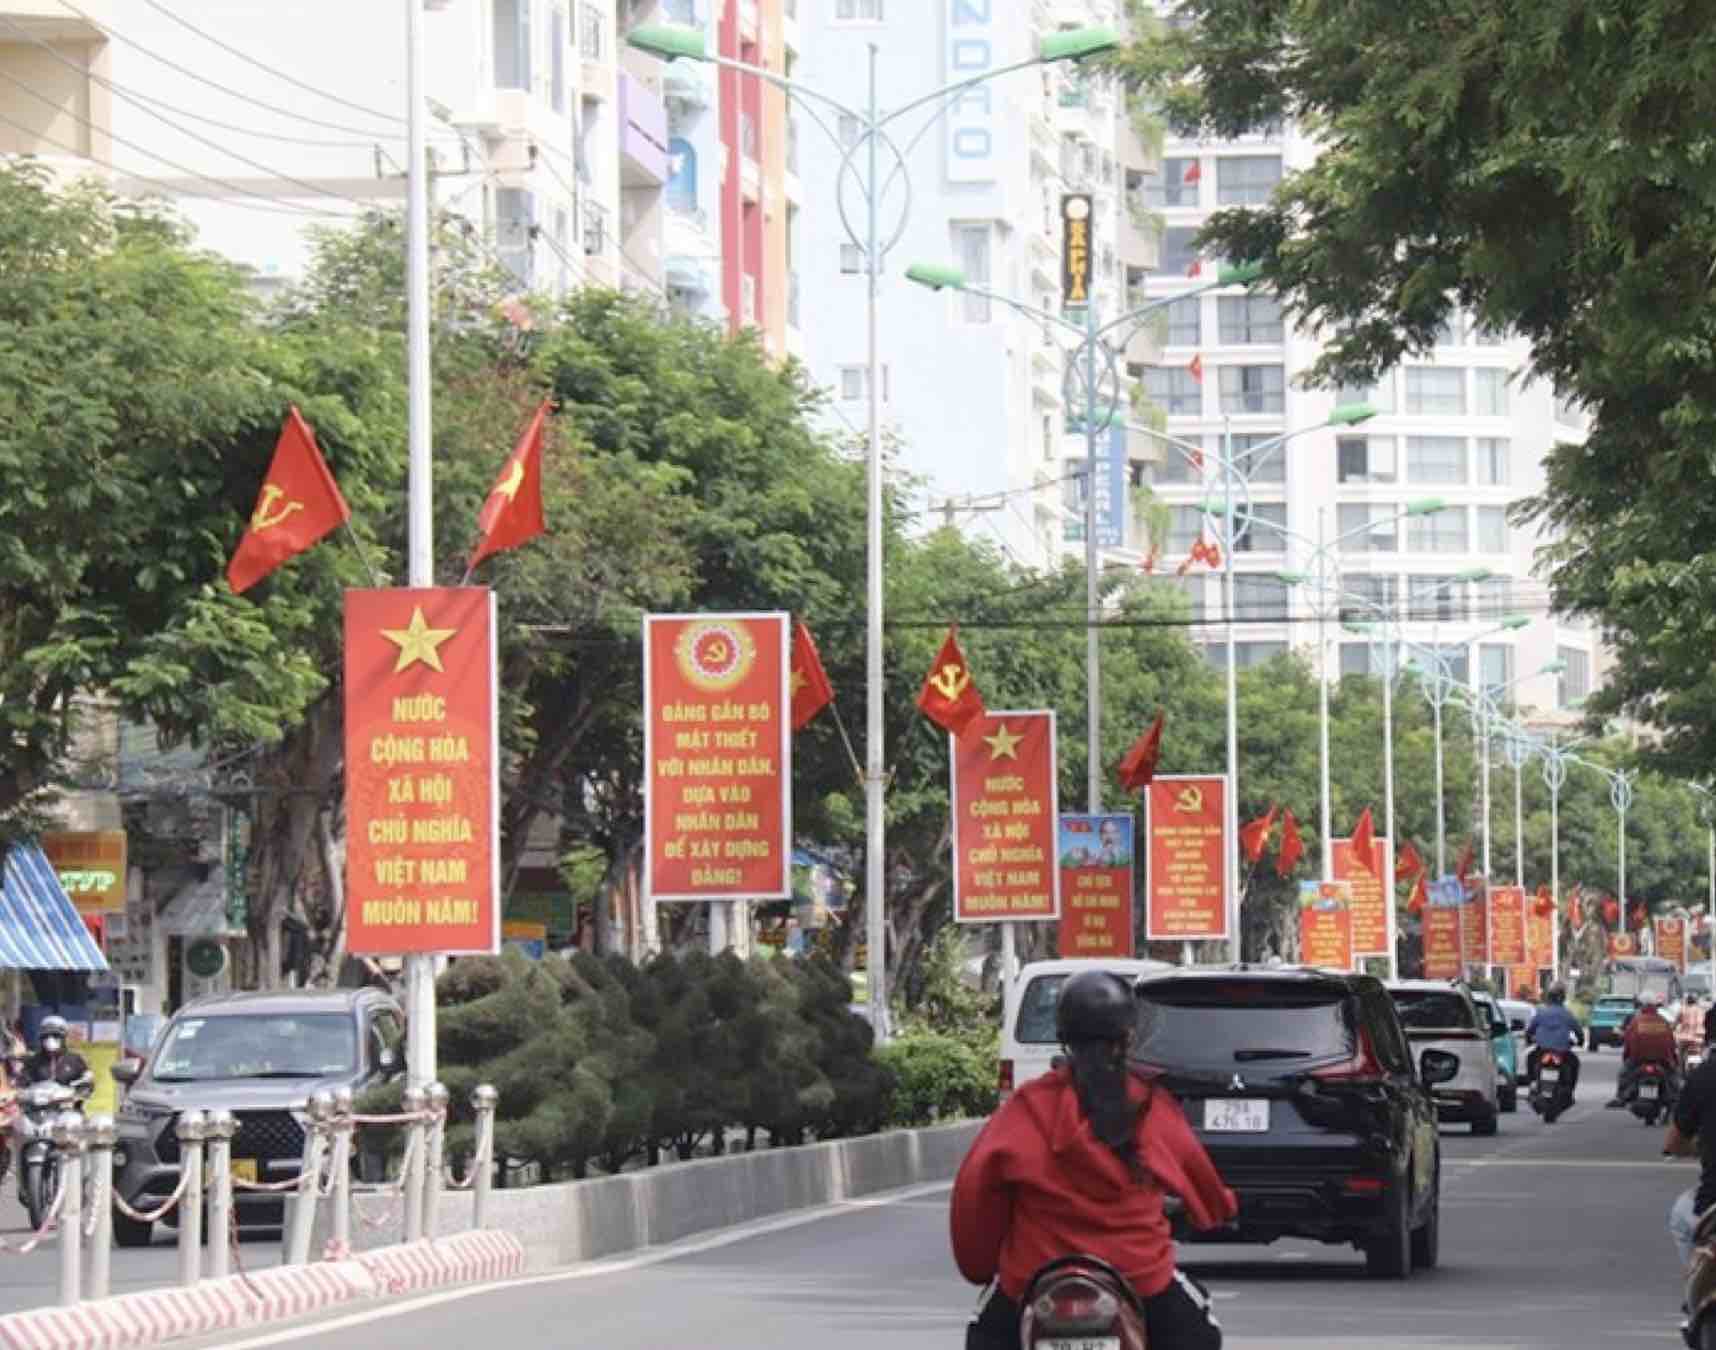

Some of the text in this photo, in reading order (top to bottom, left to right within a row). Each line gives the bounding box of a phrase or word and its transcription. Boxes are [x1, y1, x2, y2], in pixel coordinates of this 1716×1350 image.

[392, 694, 446, 722] NƯỚC
[371, 732, 469, 767] CỘNG HÒA
[419, 775, 452, 806] HỘI
[368, 813, 472, 844] CHỦ NGHĨA
[375, 857, 467, 887] VIỆT NAM
[362, 897, 478, 925] MUÔN NĂM!
